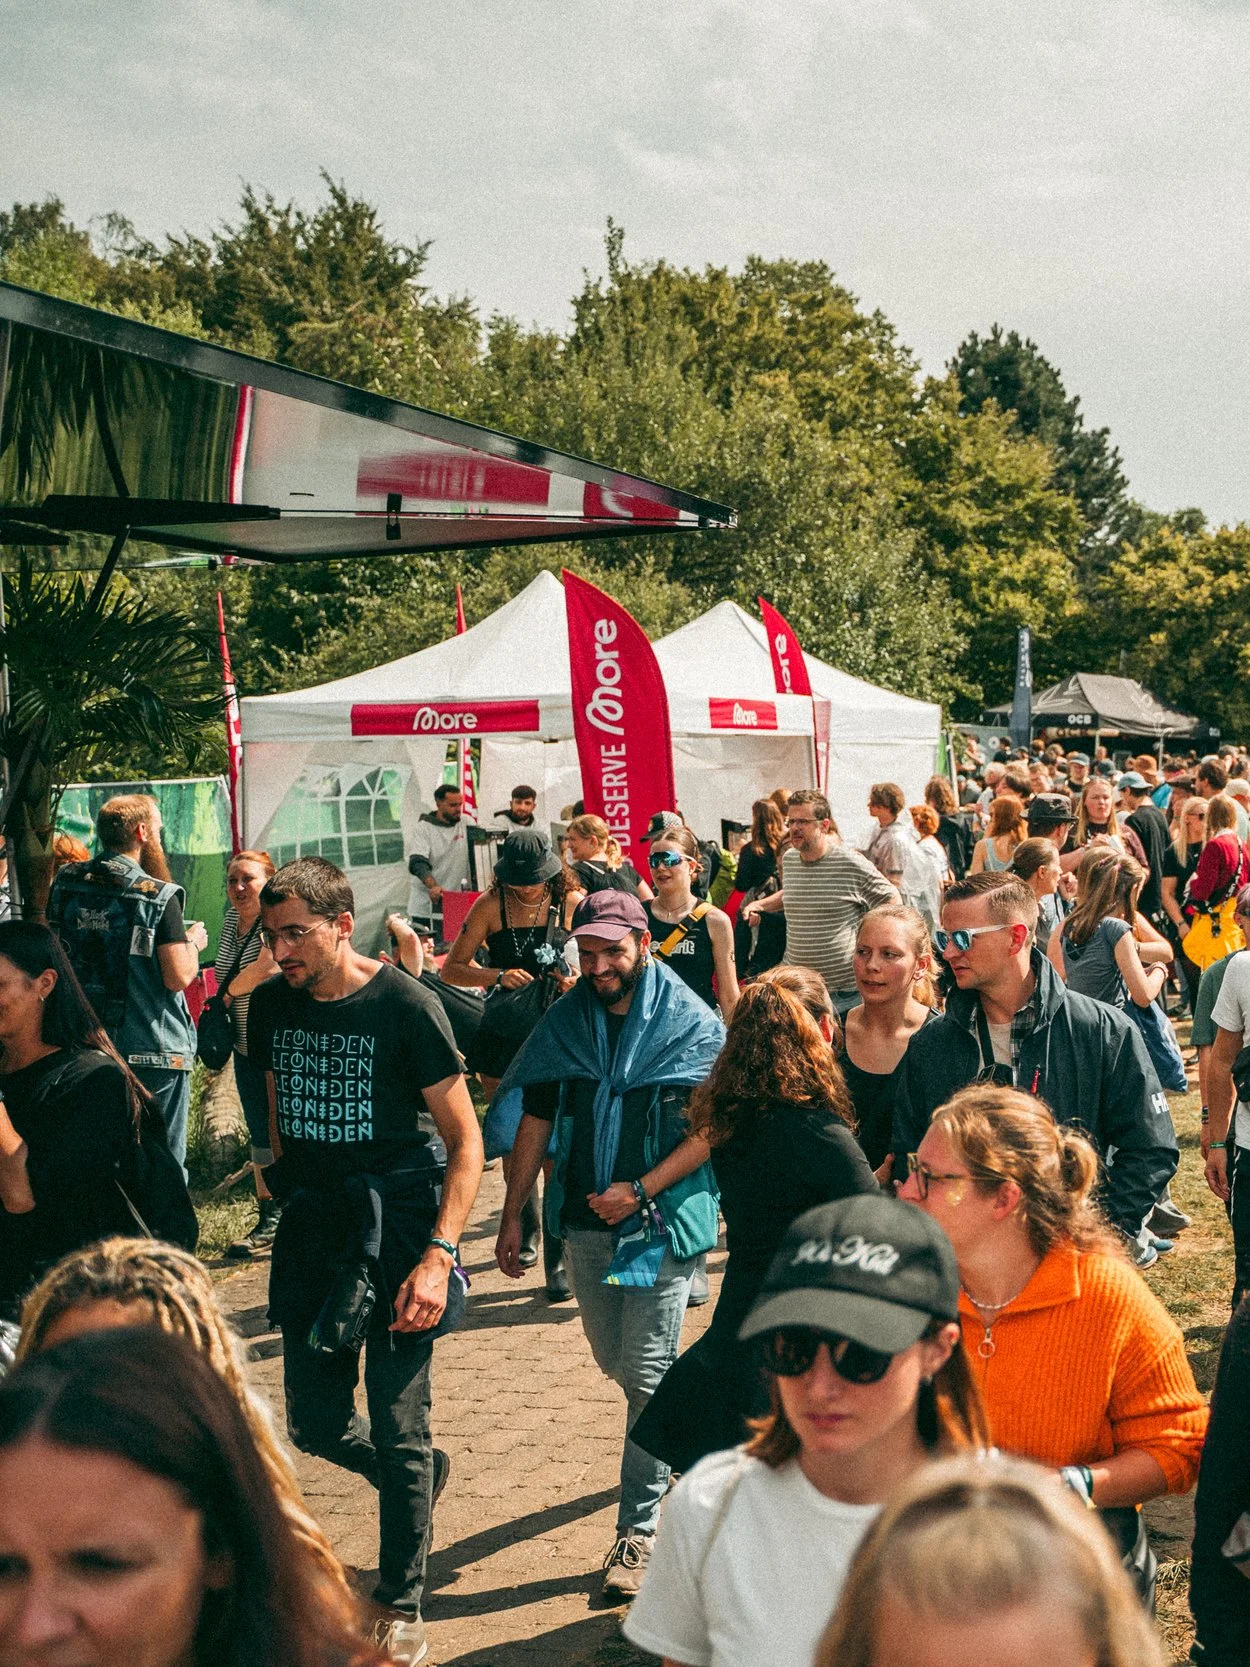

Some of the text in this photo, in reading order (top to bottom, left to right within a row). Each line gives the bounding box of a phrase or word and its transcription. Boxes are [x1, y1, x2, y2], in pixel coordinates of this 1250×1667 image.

[775, 633, 793, 694] ore
[585, 618, 624, 736] More
[412, 706, 478, 730] More
[732, 702, 758, 726] More
[1068, 714, 1092, 725] OCB
[649, 939, 695, 957] erit
